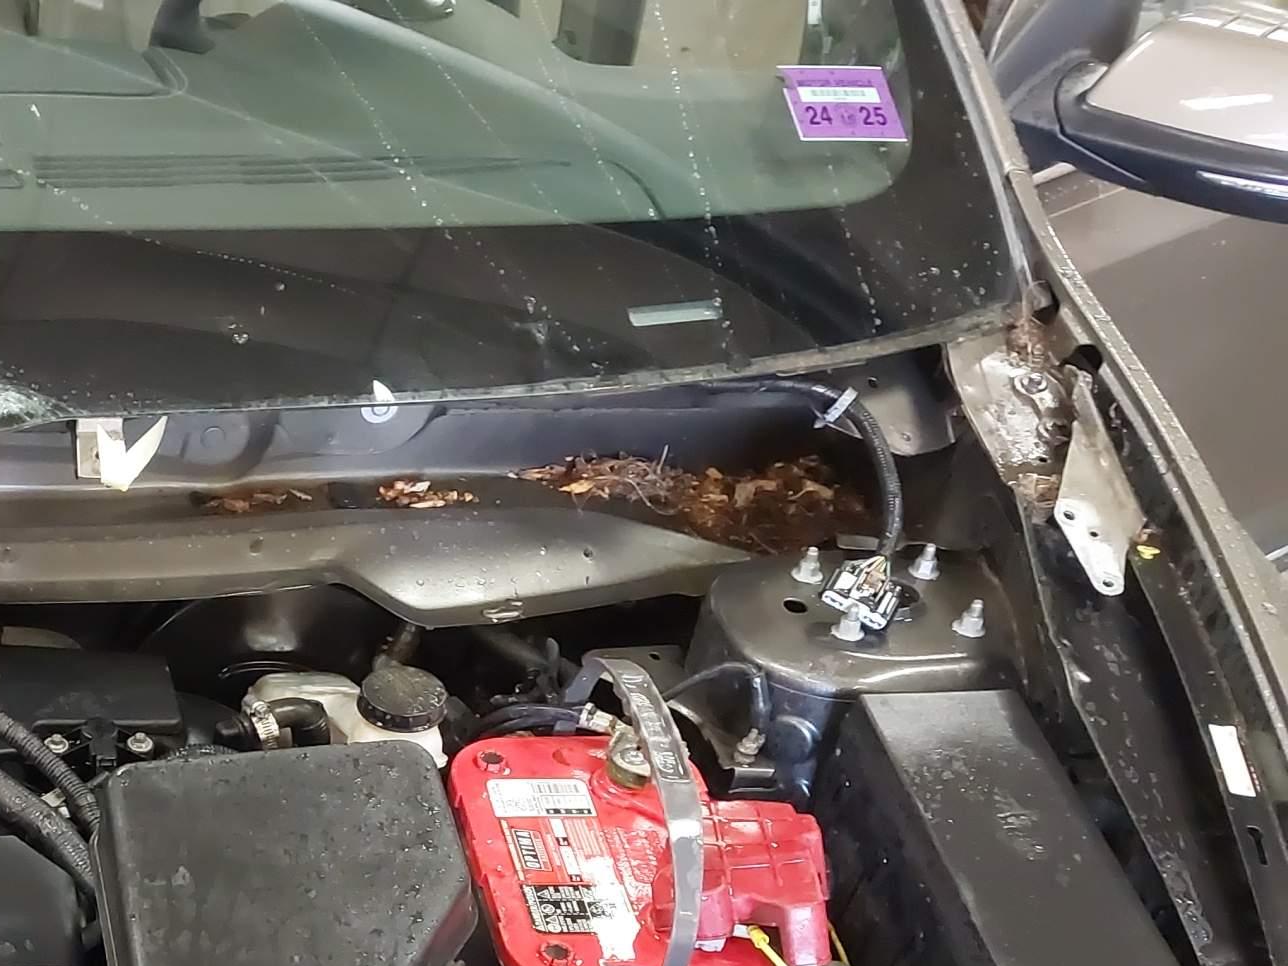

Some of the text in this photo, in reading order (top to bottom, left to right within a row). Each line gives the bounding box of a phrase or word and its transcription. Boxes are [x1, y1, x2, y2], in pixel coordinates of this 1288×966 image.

[805, 105, 832, 125] 24
[859, 106, 887, 126] 25
[514, 830, 542, 869] OPTIMA
